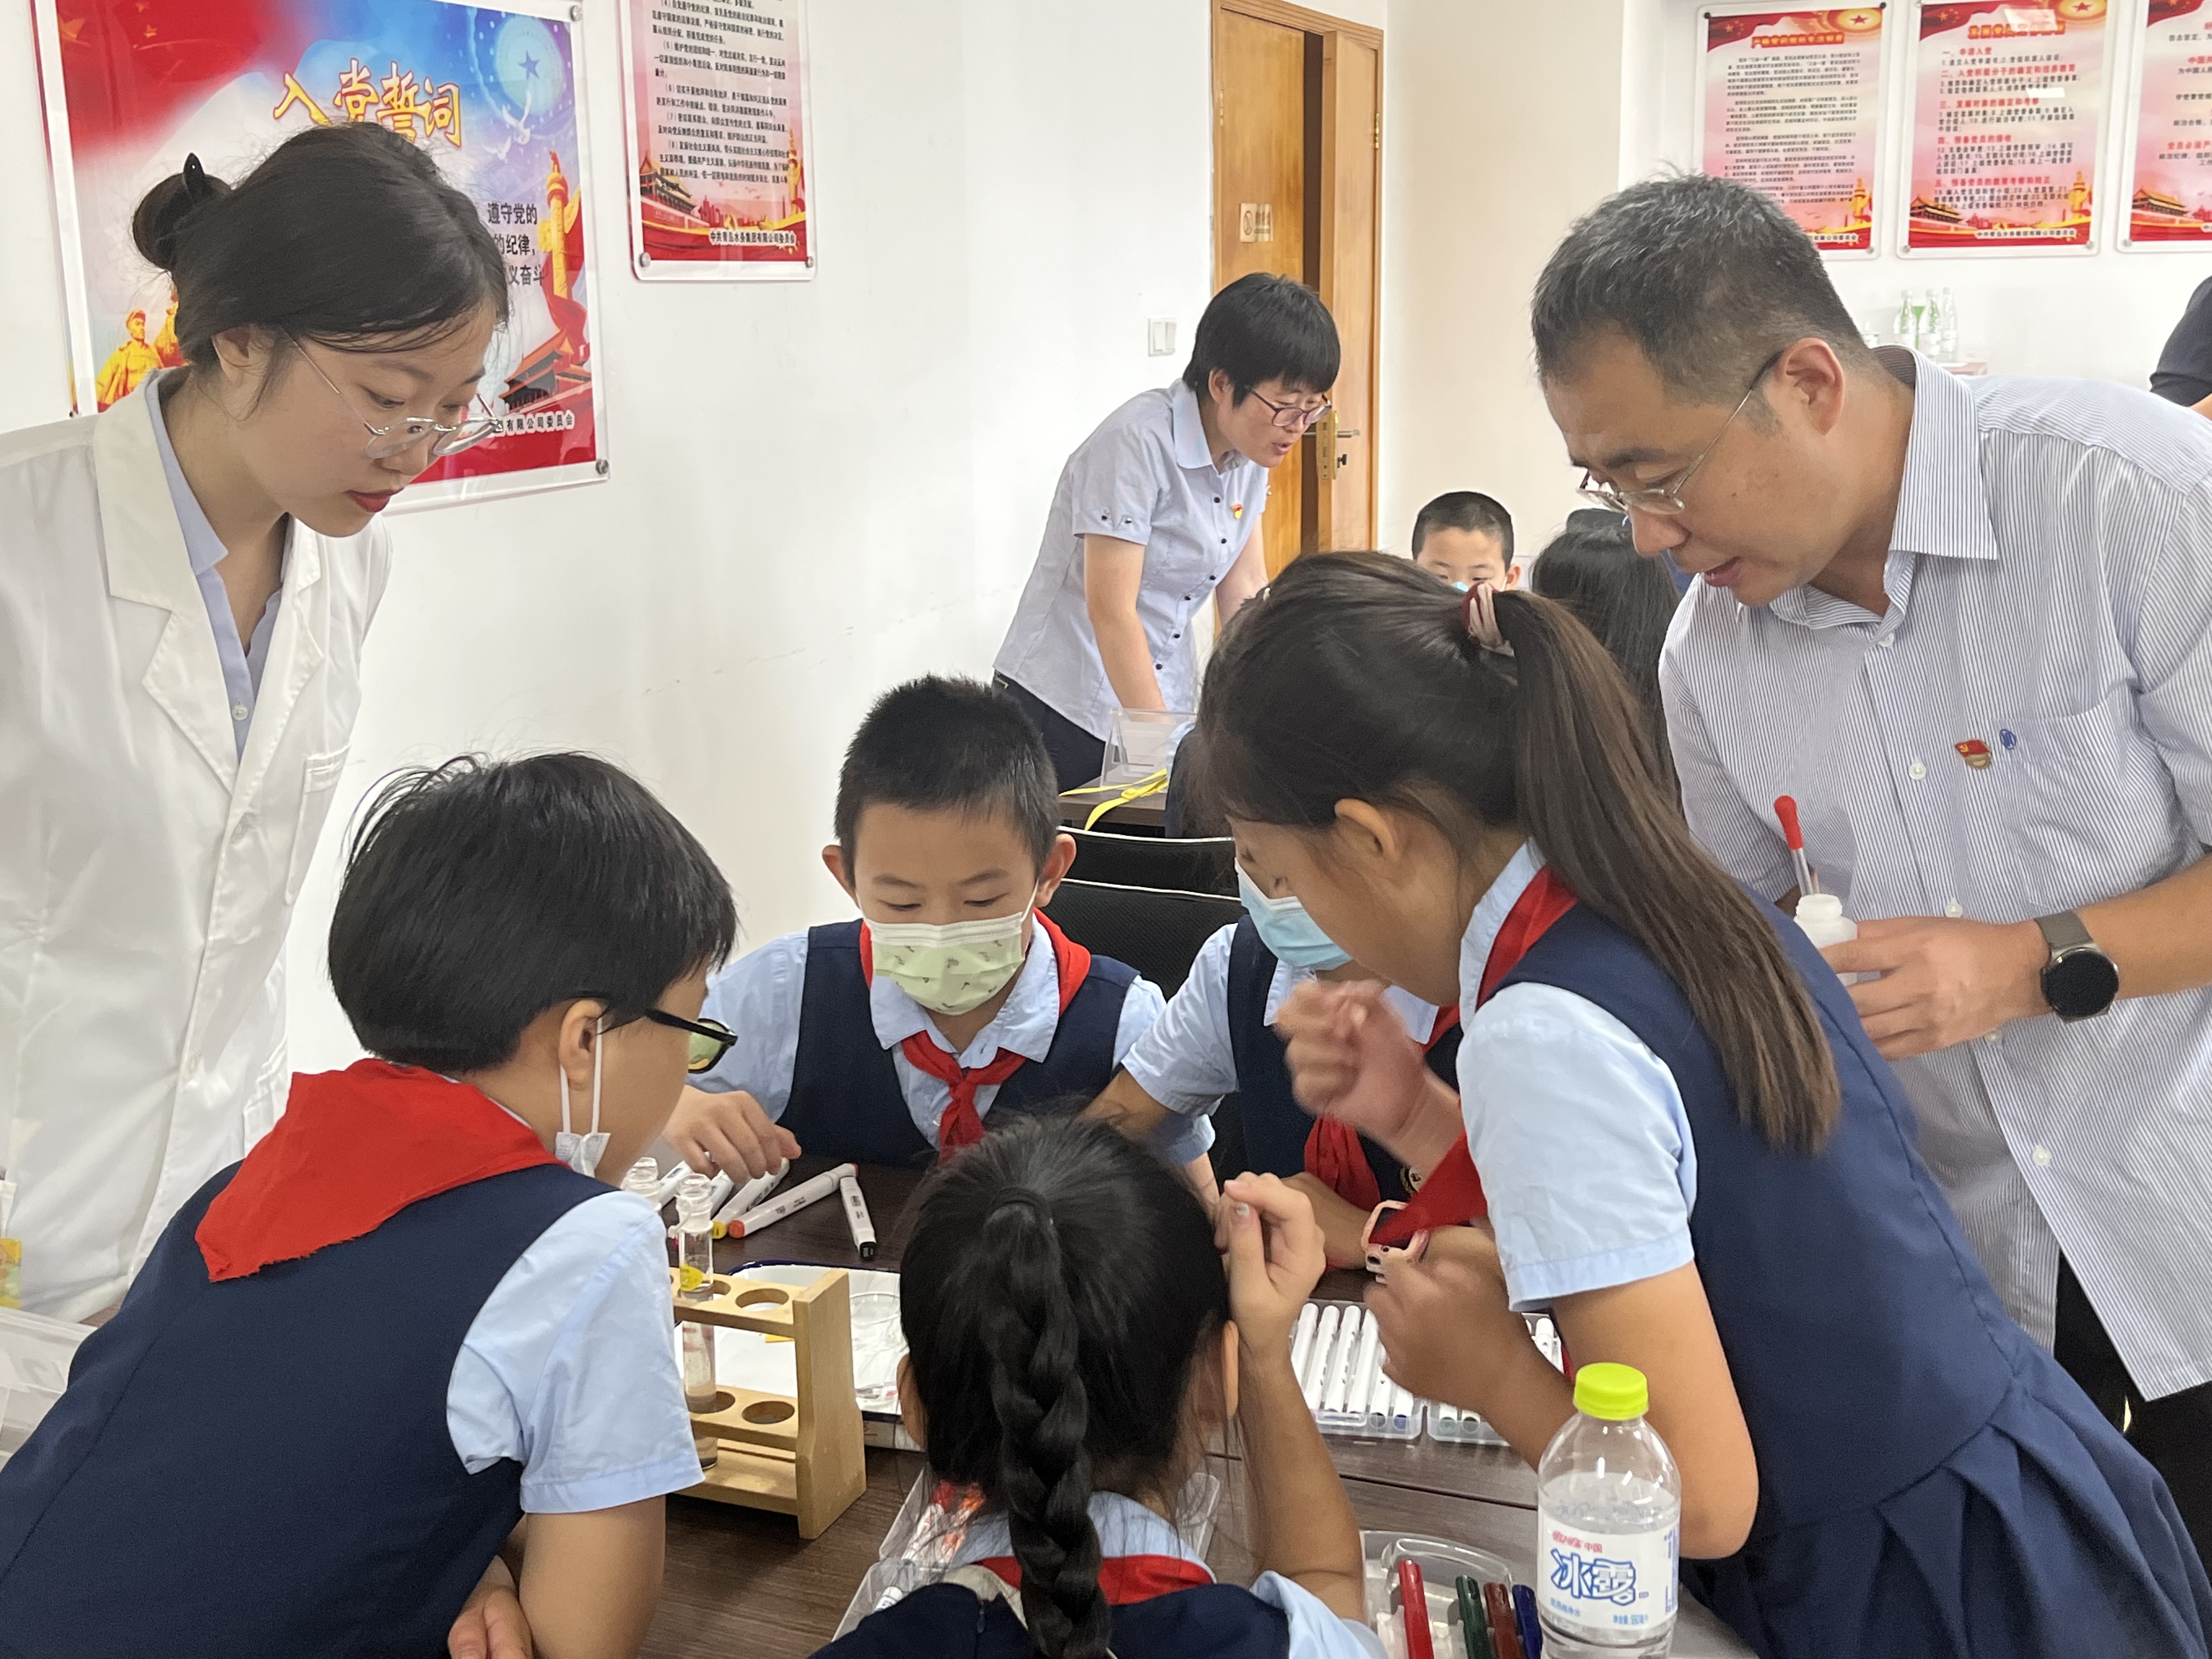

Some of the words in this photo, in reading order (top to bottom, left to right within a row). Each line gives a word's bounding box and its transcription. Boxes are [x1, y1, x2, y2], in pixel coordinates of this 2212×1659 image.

[273, 57, 462, 149] 入党誓词
[487, 202, 538, 225] 遵守党的
[508, 264, 544, 286] 义奋斗
